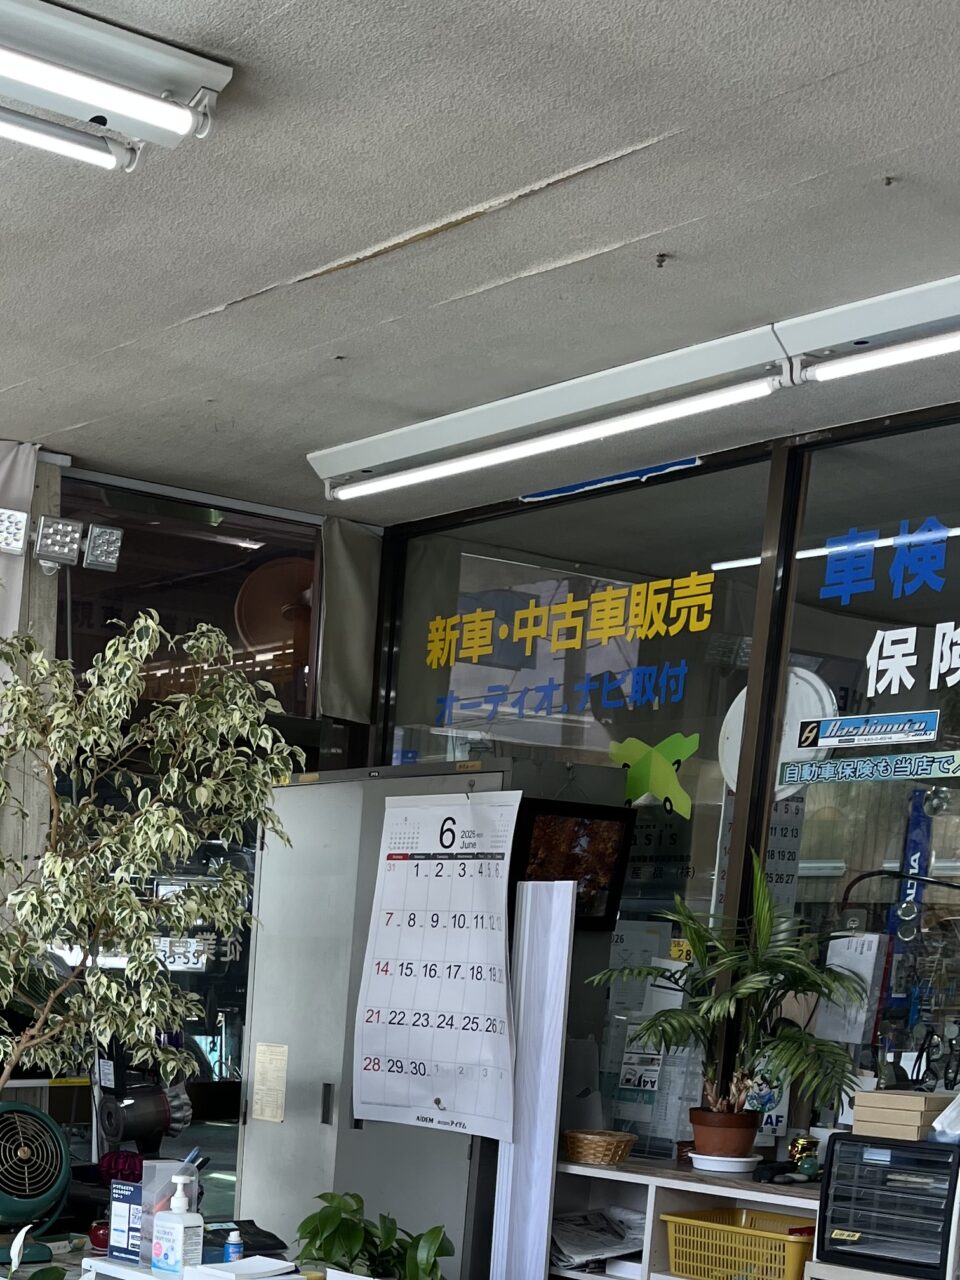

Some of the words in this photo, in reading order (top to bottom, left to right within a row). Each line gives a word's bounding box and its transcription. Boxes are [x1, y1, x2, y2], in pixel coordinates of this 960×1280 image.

[820, 516, 948, 605] 車検
[439, 816, 457, 849] 6
[781, 827, 789, 838] 12
[460, 841, 477, 850] June
[777, 850, 786, 861] 19
[787, 851, 797, 862] 20
[414, 862, 420, 877] 1
[435, 862, 444, 877] 2
[458, 862, 466, 877] 3
[478, 862, 483, 878] 4
[775, 873, 784, 884] 26
[785, 874, 795, 885] 27
[385, 912, 394, 926] 7
[407, 912, 416, 928] 8
[430, 913, 439, 928] 9
[451, 914, 466, 929] 10
[474, 914, 484, 929] 11
[375, 961, 389, 976] 14
[398, 962, 414, 977] 15
[422, 963, 437, 979] 16
[446, 964, 461, 980] 17
[469, 965, 483, 981] 18
[365, 1009, 381, 1024] 21
[388, 1010, 406, 1026] 22
[412, 1012, 430, 1028] 23
[436, 1014, 454, 1030] 24
[462, 1015, 480, 1032] 25
[485, 1017, 497, 1034] 26
[363, 1056, 381, 1072] 28
[387, 1059, 404, 1074] 29
[410, 1061, 426, 1077] 30
